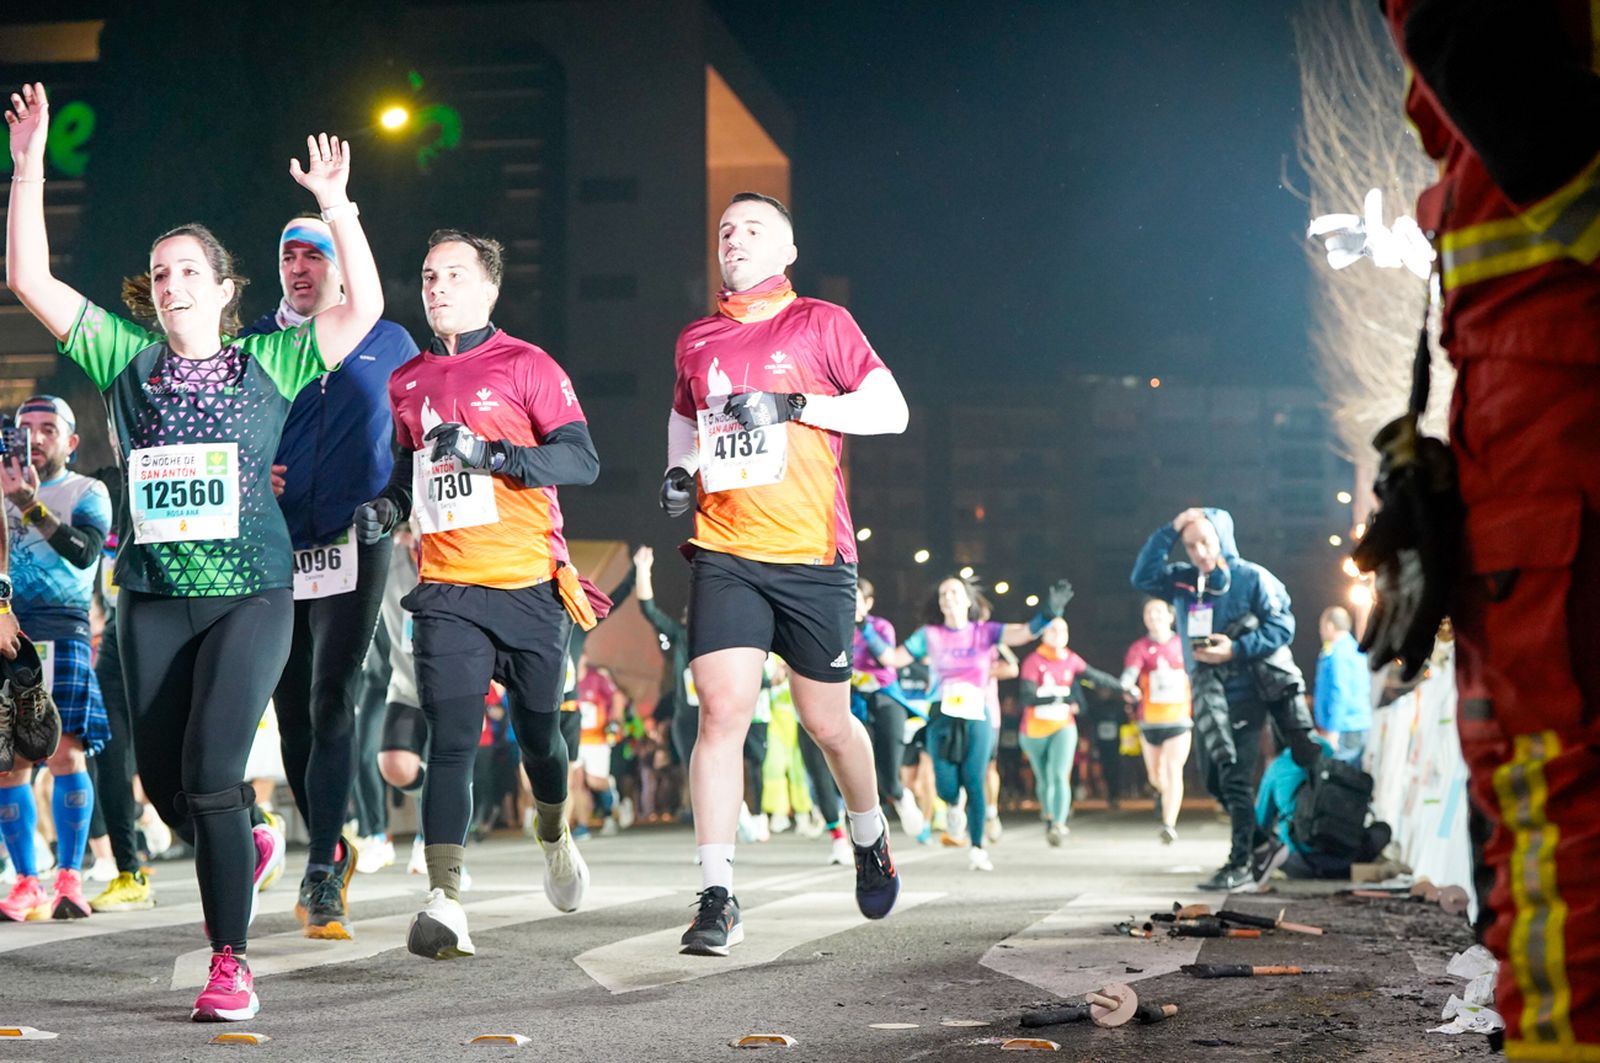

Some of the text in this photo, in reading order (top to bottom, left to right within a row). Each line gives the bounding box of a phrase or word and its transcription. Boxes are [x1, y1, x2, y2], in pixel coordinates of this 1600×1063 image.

[714, 429, 768, 460] 4732
[152, 455, 195, 466] NOCHE DE
[141, 468, 160, 480] SAN
[142, 478, 224, 510] 12560
